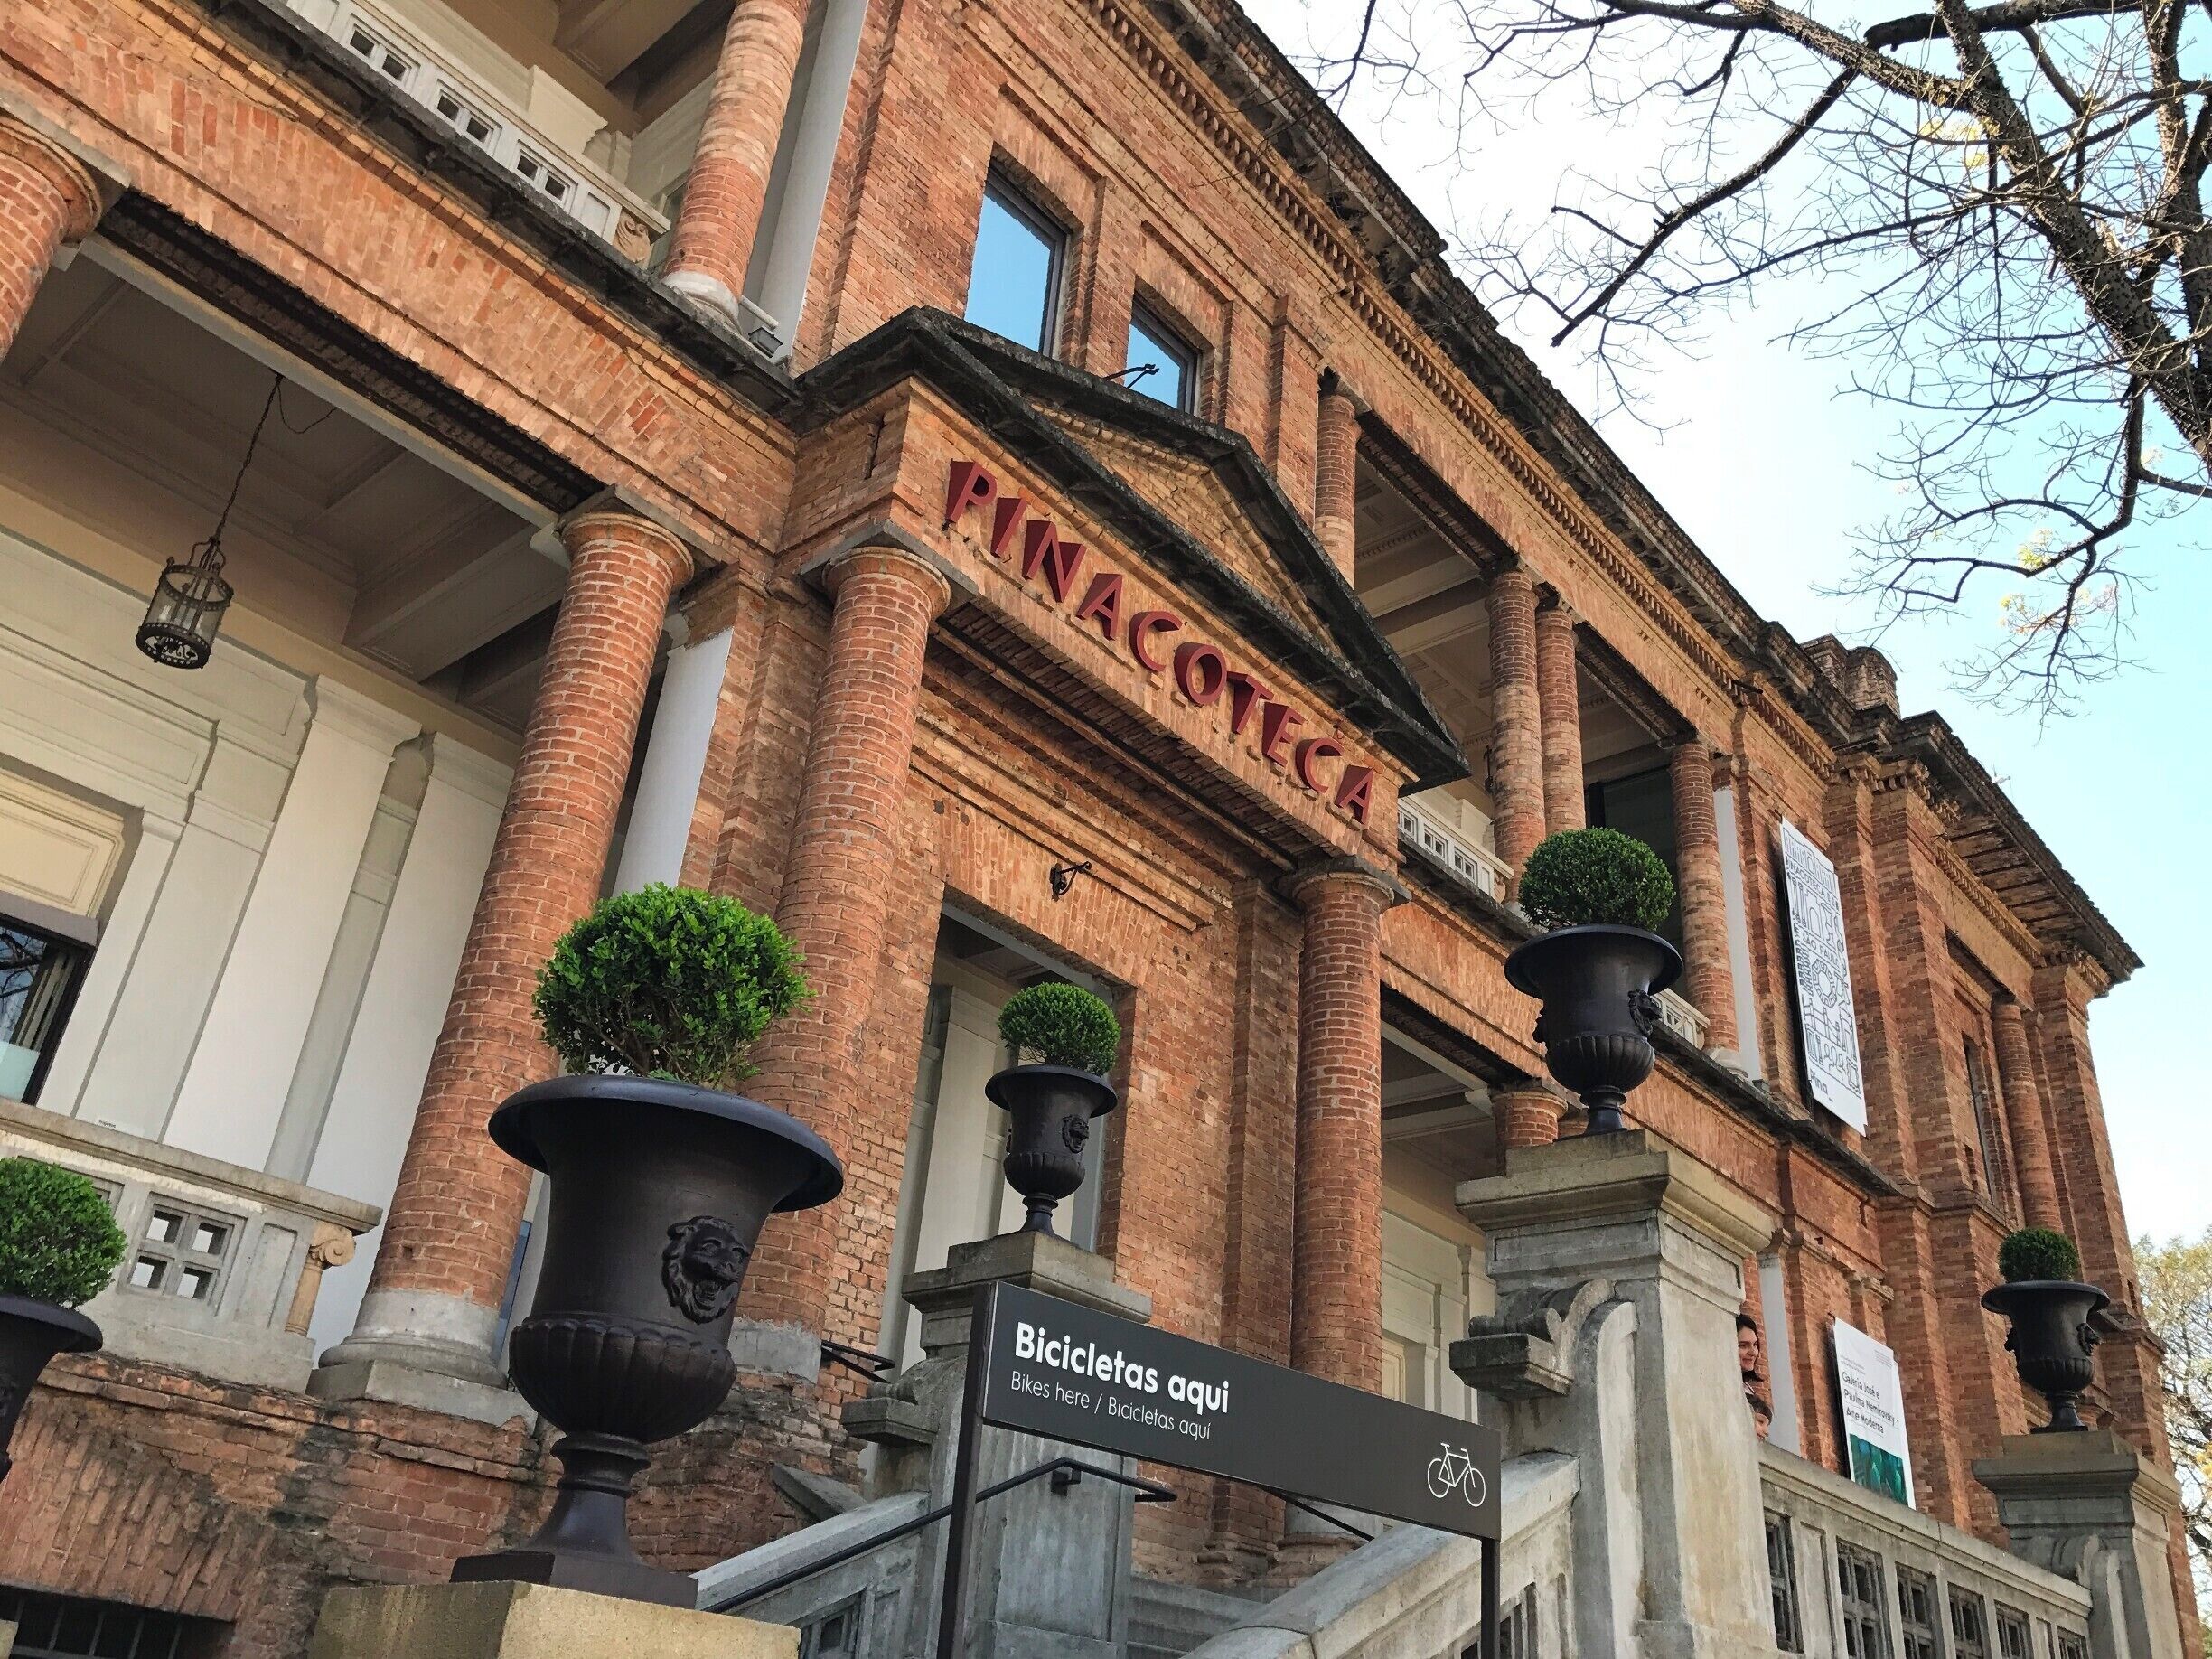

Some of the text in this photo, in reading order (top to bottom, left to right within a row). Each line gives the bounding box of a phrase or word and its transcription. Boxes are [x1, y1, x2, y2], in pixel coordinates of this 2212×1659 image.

[945, 459, 1374, 826] PINACOTECA
[1011, 1370, 1212, 1441] Bikes here / Bicicletas aquí
[1015, 1321, 1230, 1416] Bicicletas aqui
[1842, 1372, 1863, 1391] Galeria
